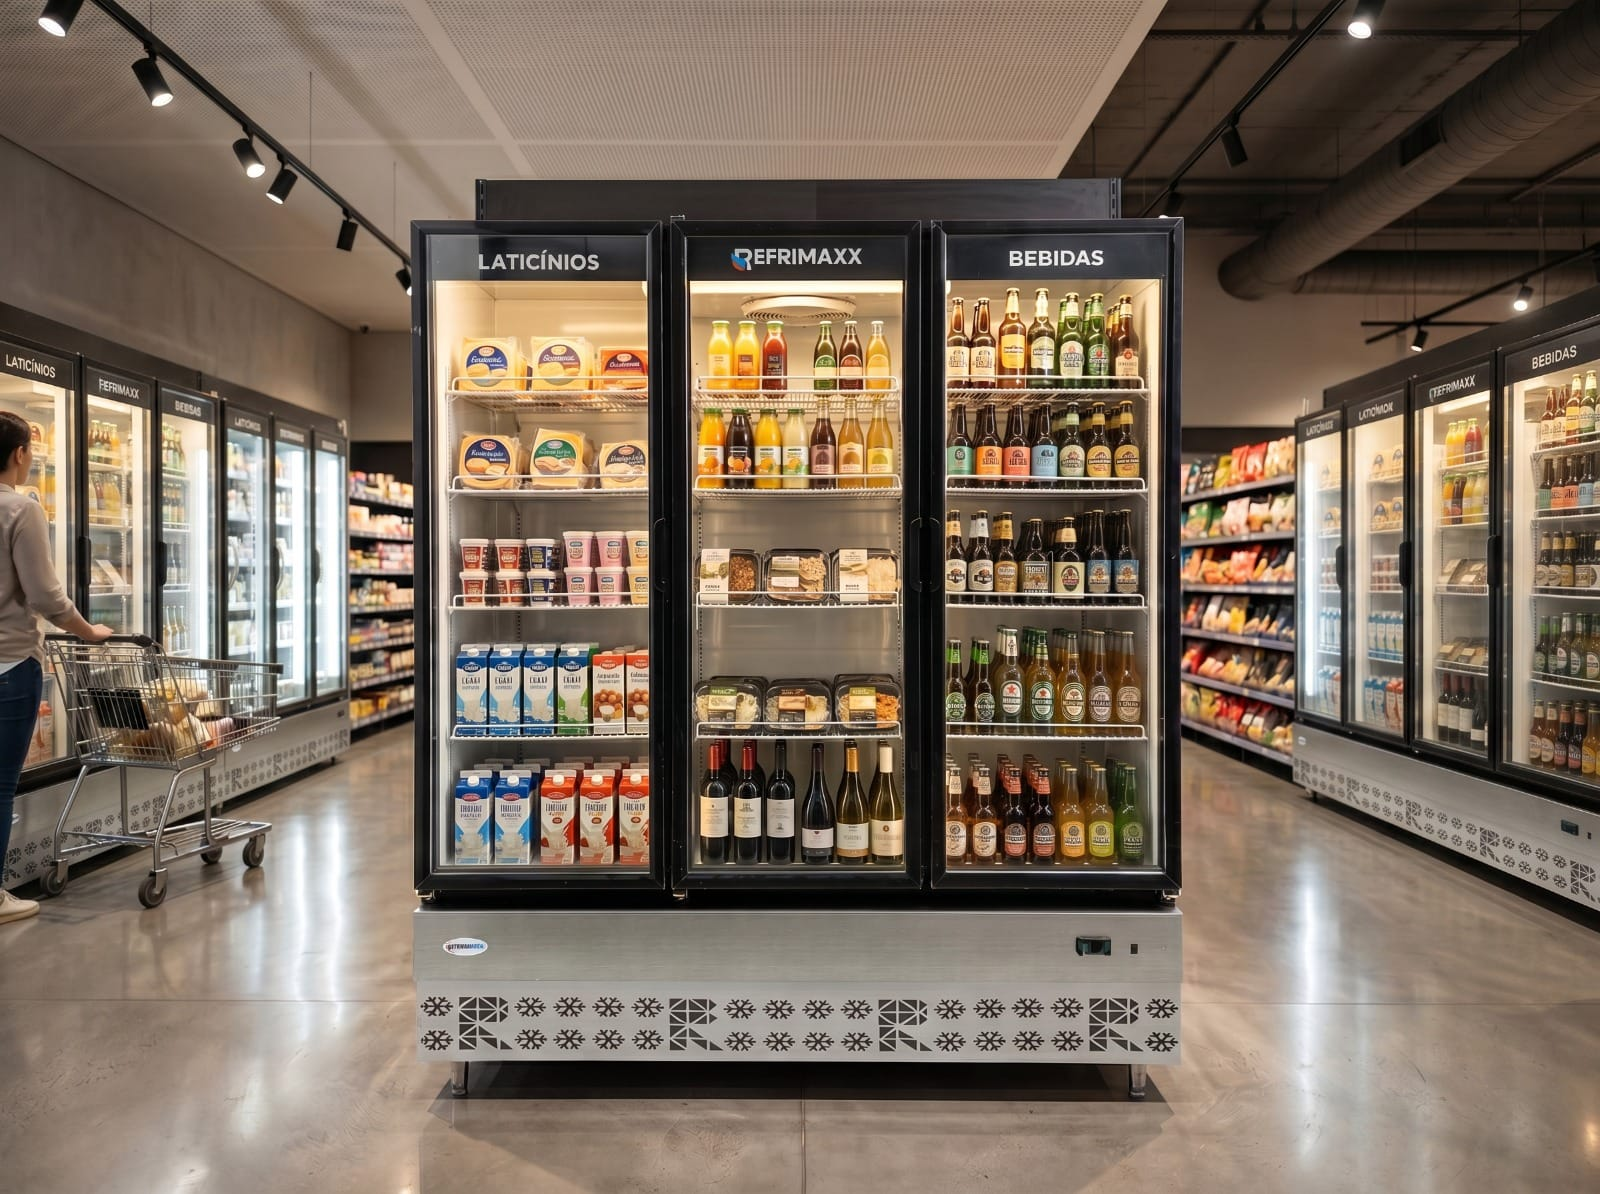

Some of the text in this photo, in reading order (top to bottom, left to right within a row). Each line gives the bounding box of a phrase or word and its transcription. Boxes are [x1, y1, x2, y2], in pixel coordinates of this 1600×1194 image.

[478, 249, 600, 271] LATICÍNIOS
[731, 247, 862, 271] REFRIMAXX
[1009, 250, 1104, 267] BEBIDAS
[5, 354, 56, 378] LATICÍNIOS
[1532, 345, 1577, 370] BEBIDAS
